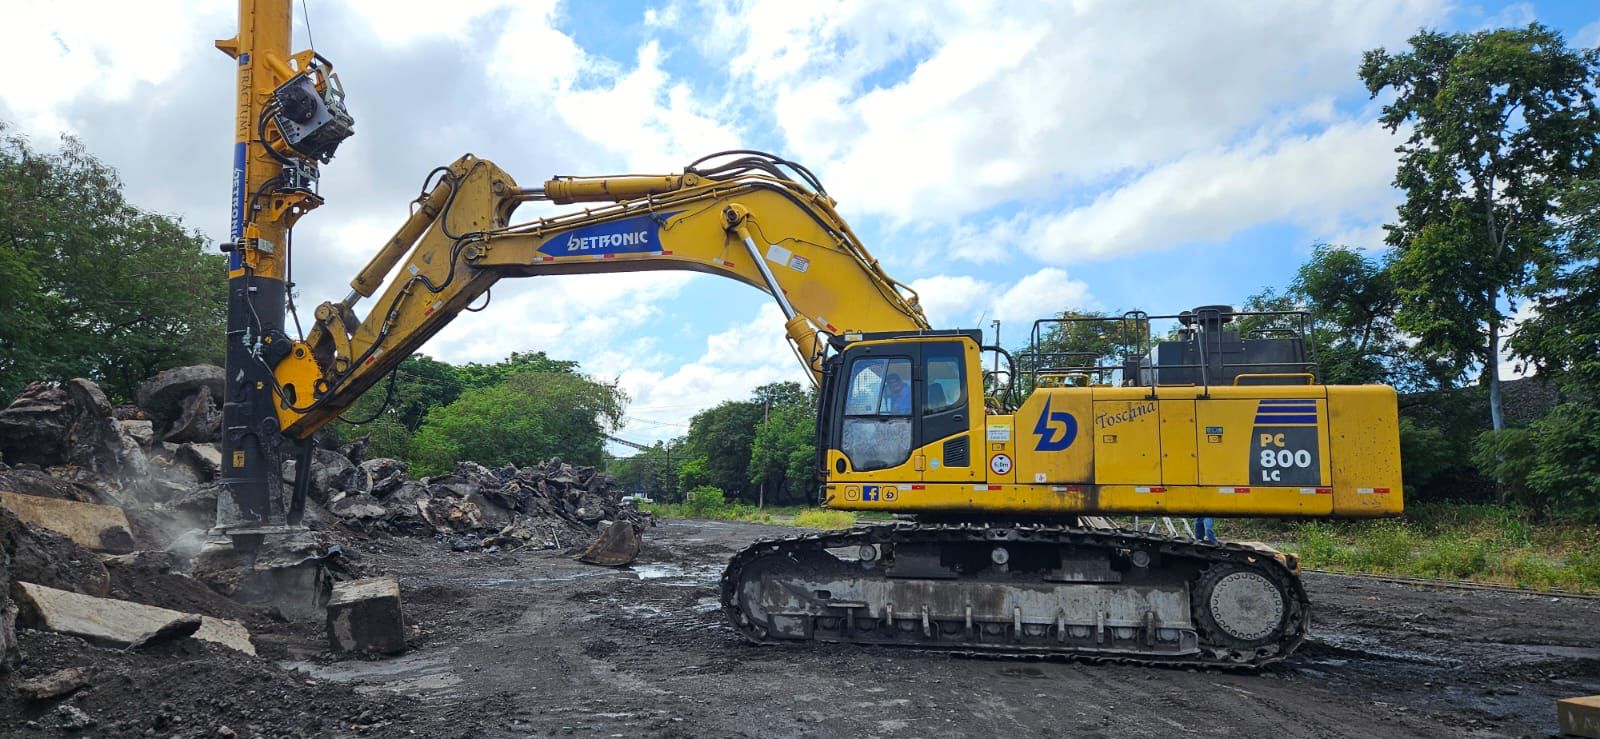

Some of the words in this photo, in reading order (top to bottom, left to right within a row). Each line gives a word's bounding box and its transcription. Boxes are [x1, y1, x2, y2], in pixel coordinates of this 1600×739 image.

[567, 231, 648, 251] DETRONIC
[1260, 433, 1285, 447] PC
[1260, 449, 1311, 468] 800
[1262, 469, 1281, 482] LC
